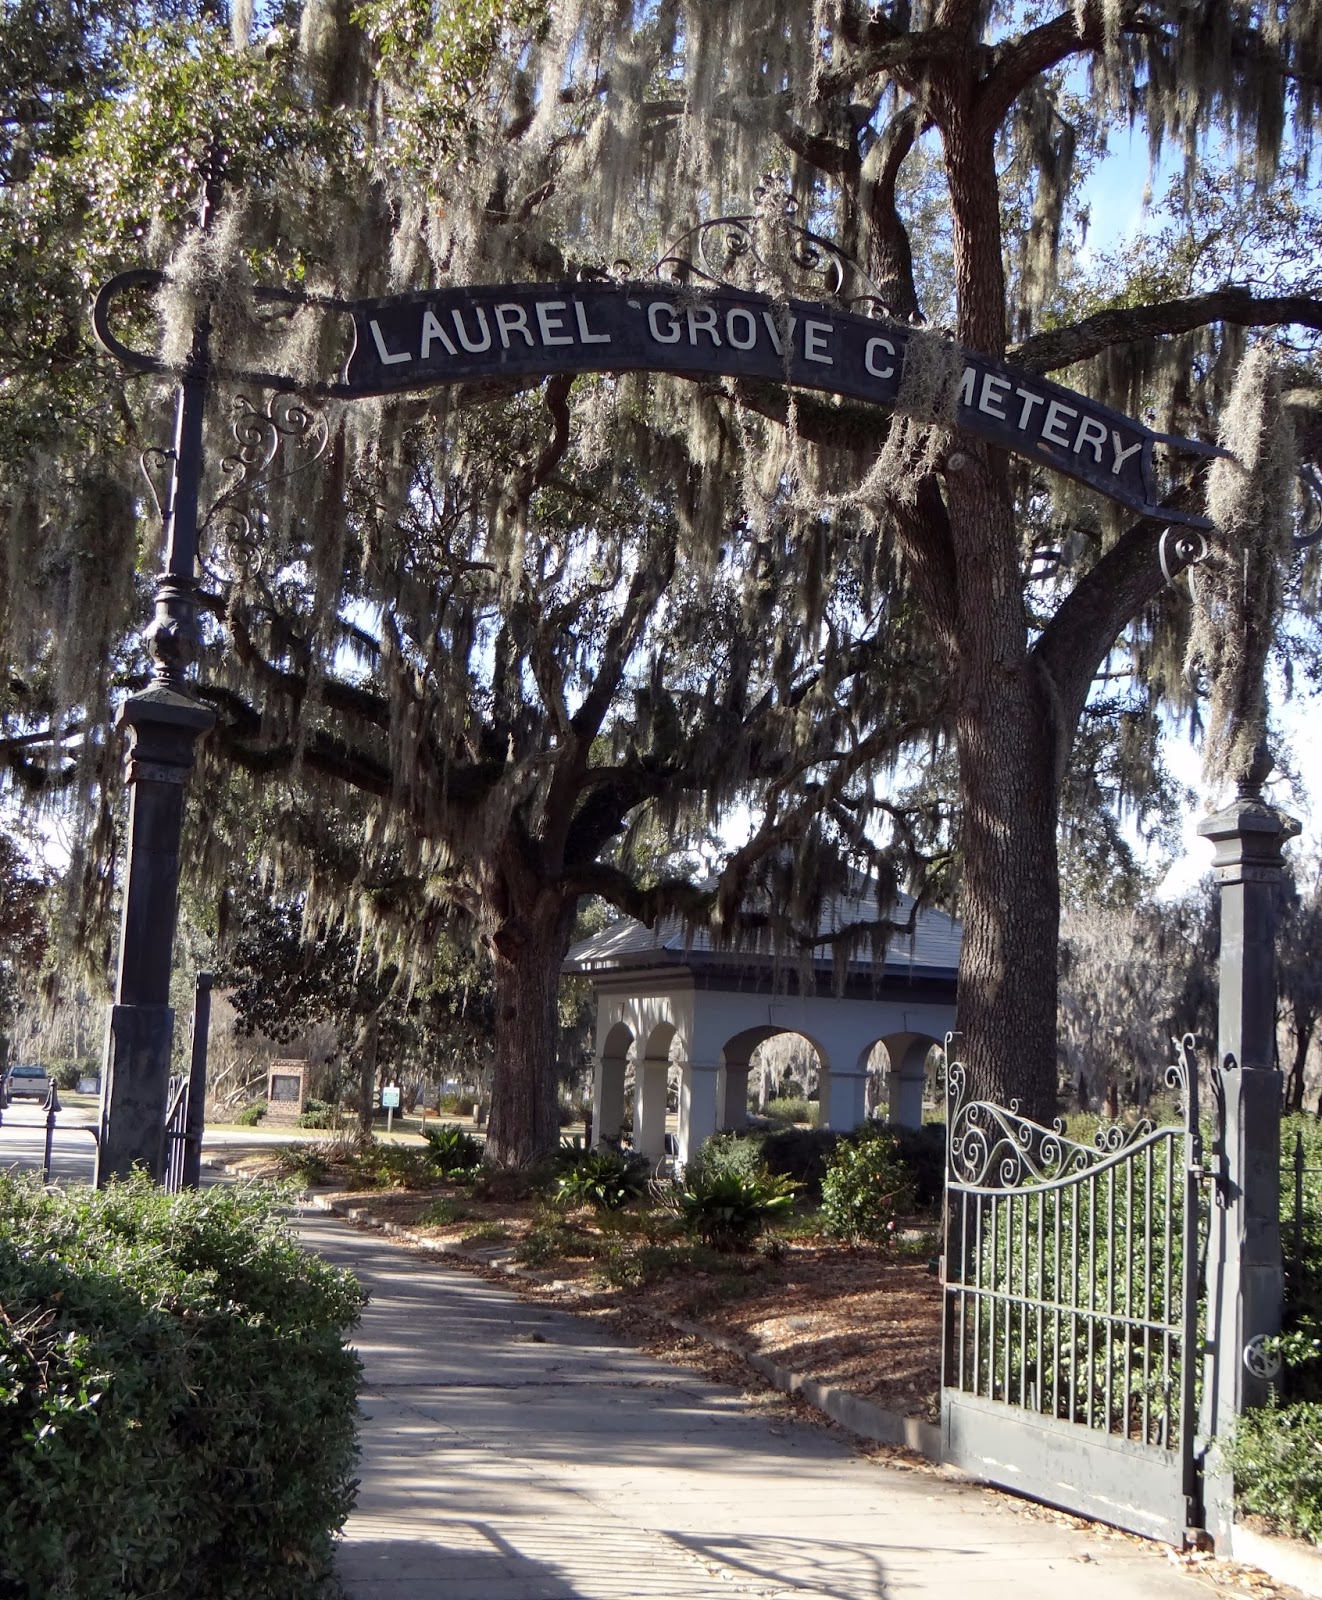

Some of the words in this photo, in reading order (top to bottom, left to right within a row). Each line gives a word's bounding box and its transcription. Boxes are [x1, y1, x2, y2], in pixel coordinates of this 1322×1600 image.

[369, 301, 611, 365] LAUREL
[647, 301, 834, 365] GROVE
[865, 337, 1142, 475] CMETERY
